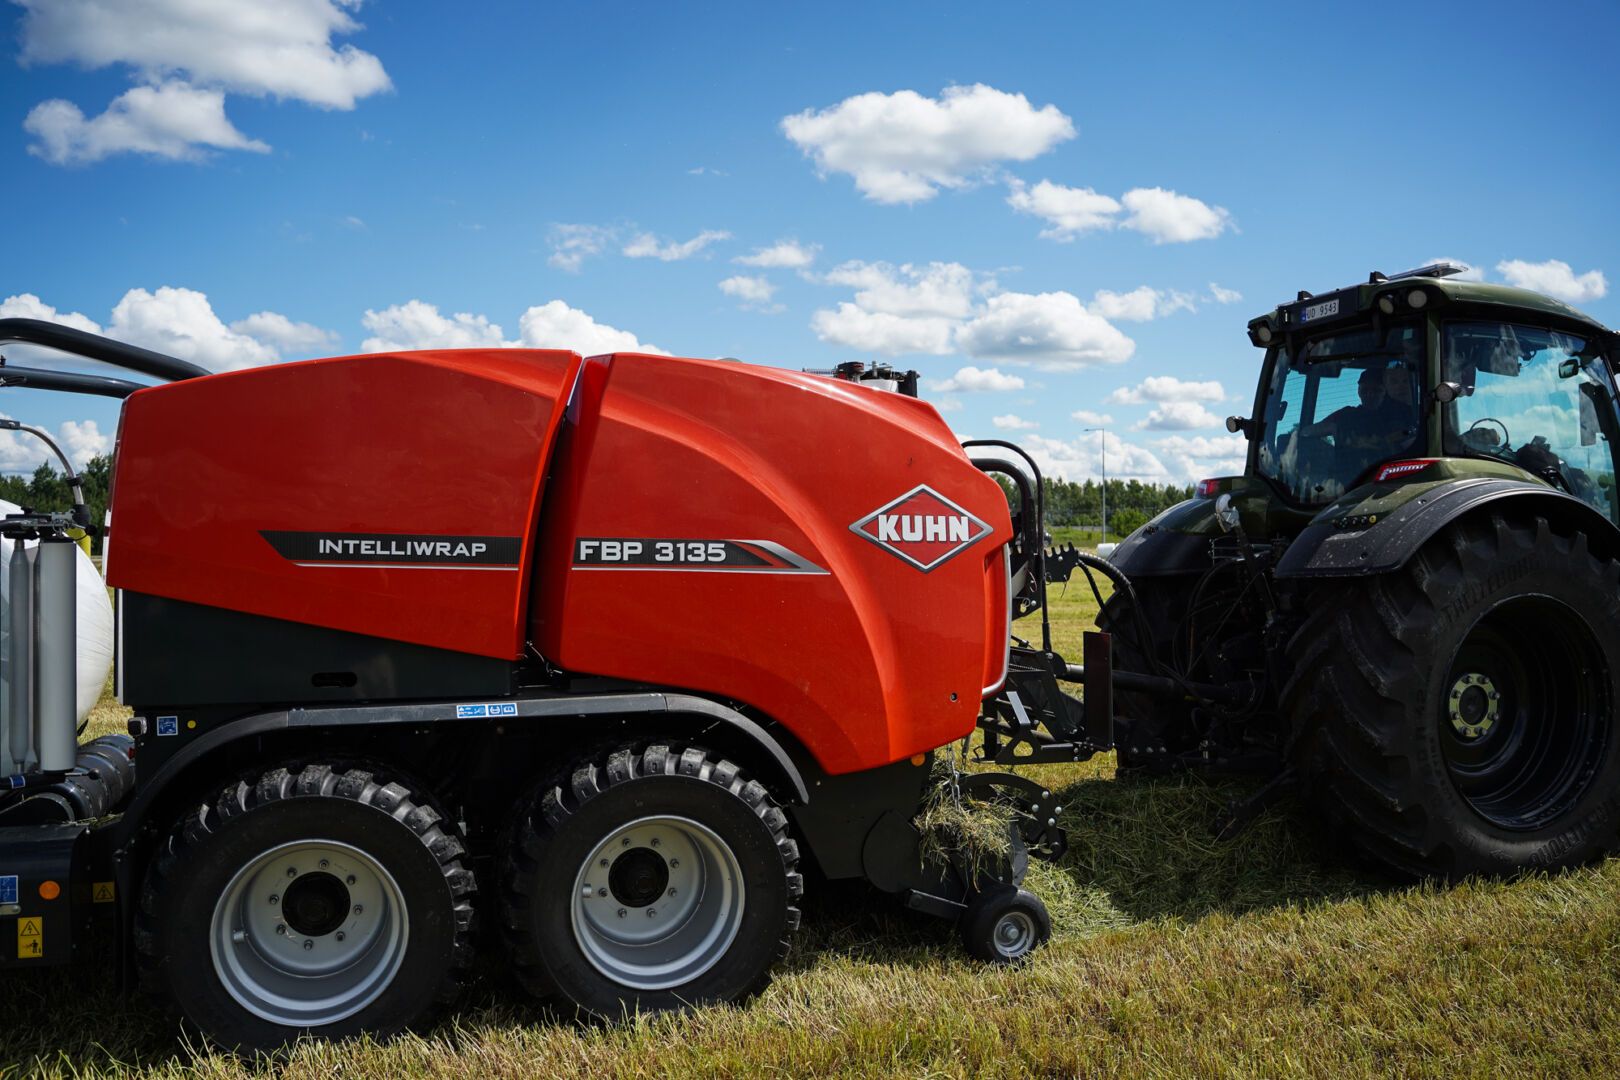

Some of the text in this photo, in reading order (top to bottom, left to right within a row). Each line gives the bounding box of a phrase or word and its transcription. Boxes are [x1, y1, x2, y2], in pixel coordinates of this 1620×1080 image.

[1319, 302, 1337, 316] 9543
[878, 514, 969, 542] KUHN
[319, 539, 487, 557] INTELLIWRAP
[579, 540, 727, 562] FBP 3135
